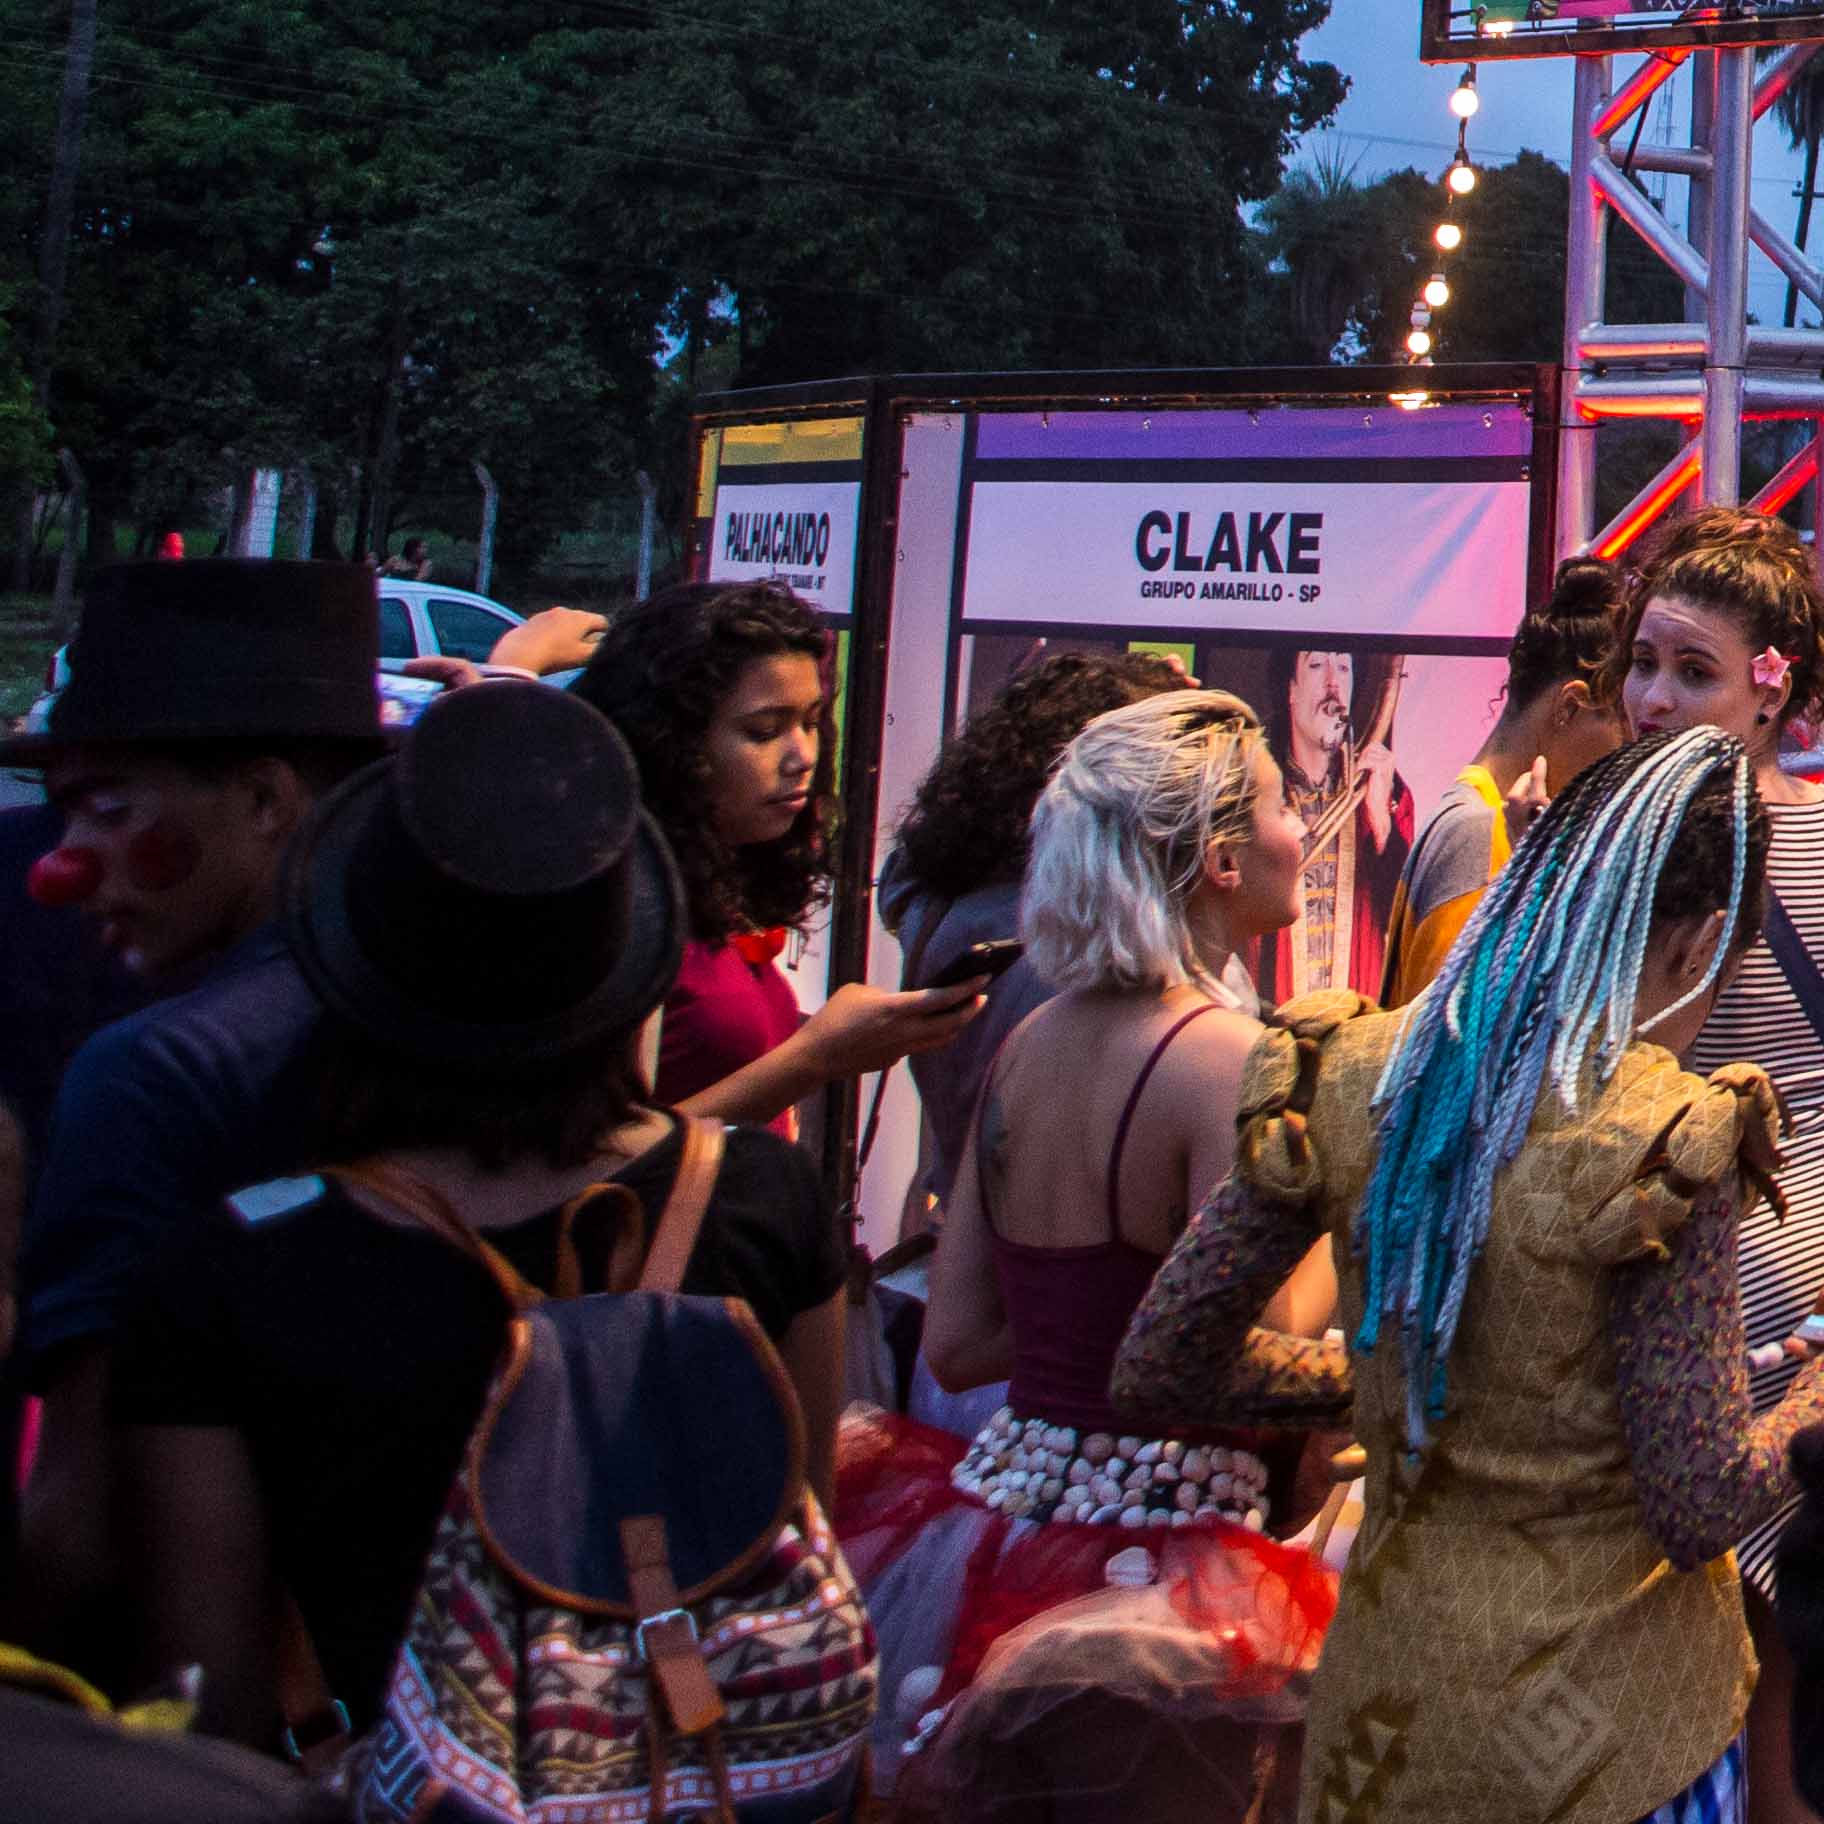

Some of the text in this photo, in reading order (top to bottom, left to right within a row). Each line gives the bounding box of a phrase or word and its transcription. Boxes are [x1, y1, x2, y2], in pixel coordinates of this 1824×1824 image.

[1136, 510, 1324, 574] CLAKE
[1140, 581, 1196, 600] GRUPO
[1200, 582, 1283, 602] AMARILLO
[1299, 584, 1322, 603] SP
